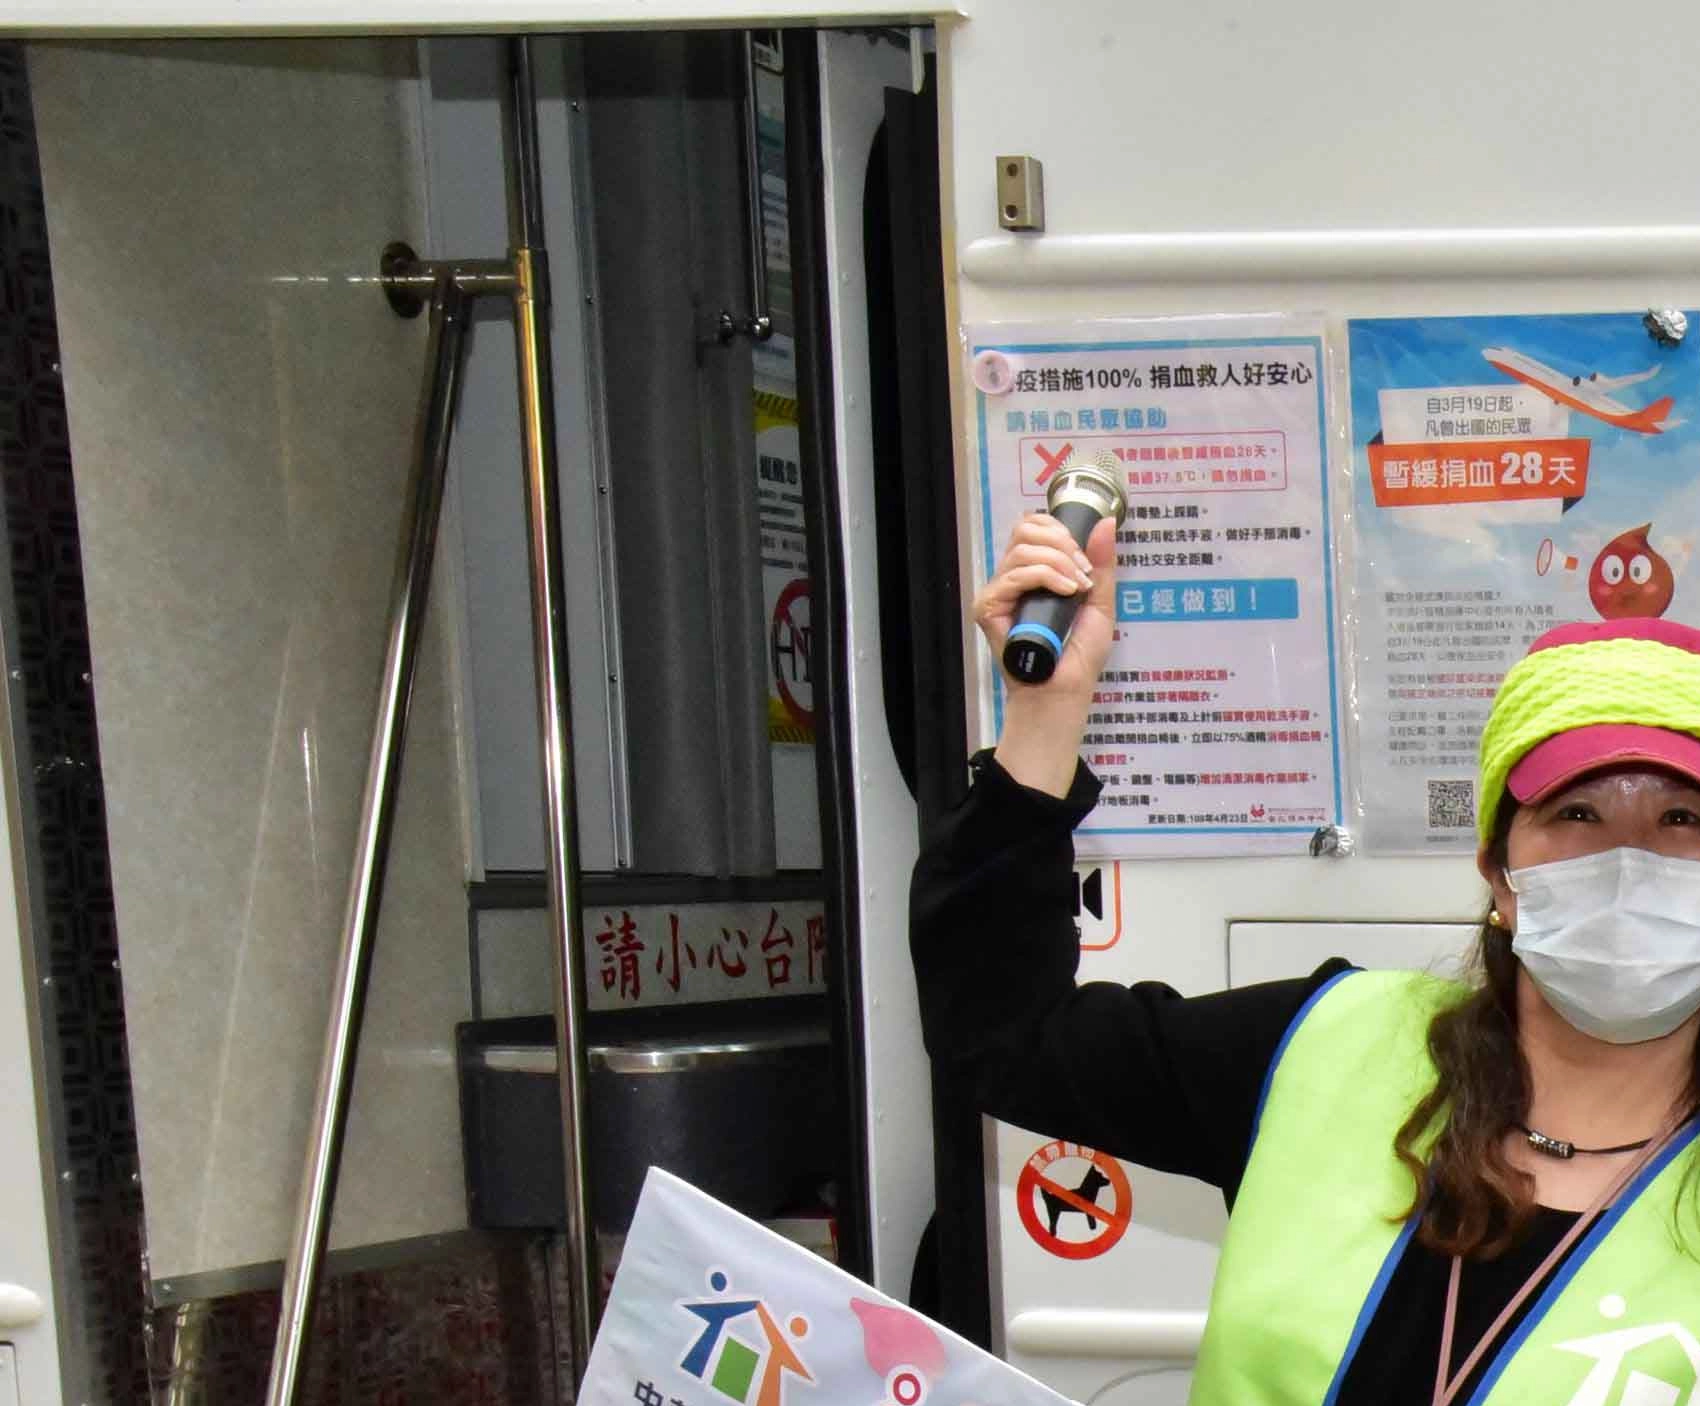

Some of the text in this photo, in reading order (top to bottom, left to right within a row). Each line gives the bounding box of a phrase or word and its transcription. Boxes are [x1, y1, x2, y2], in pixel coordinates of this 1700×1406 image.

[1010, 362, 1312, 393] 疫措施100% 捐血救人好安心
